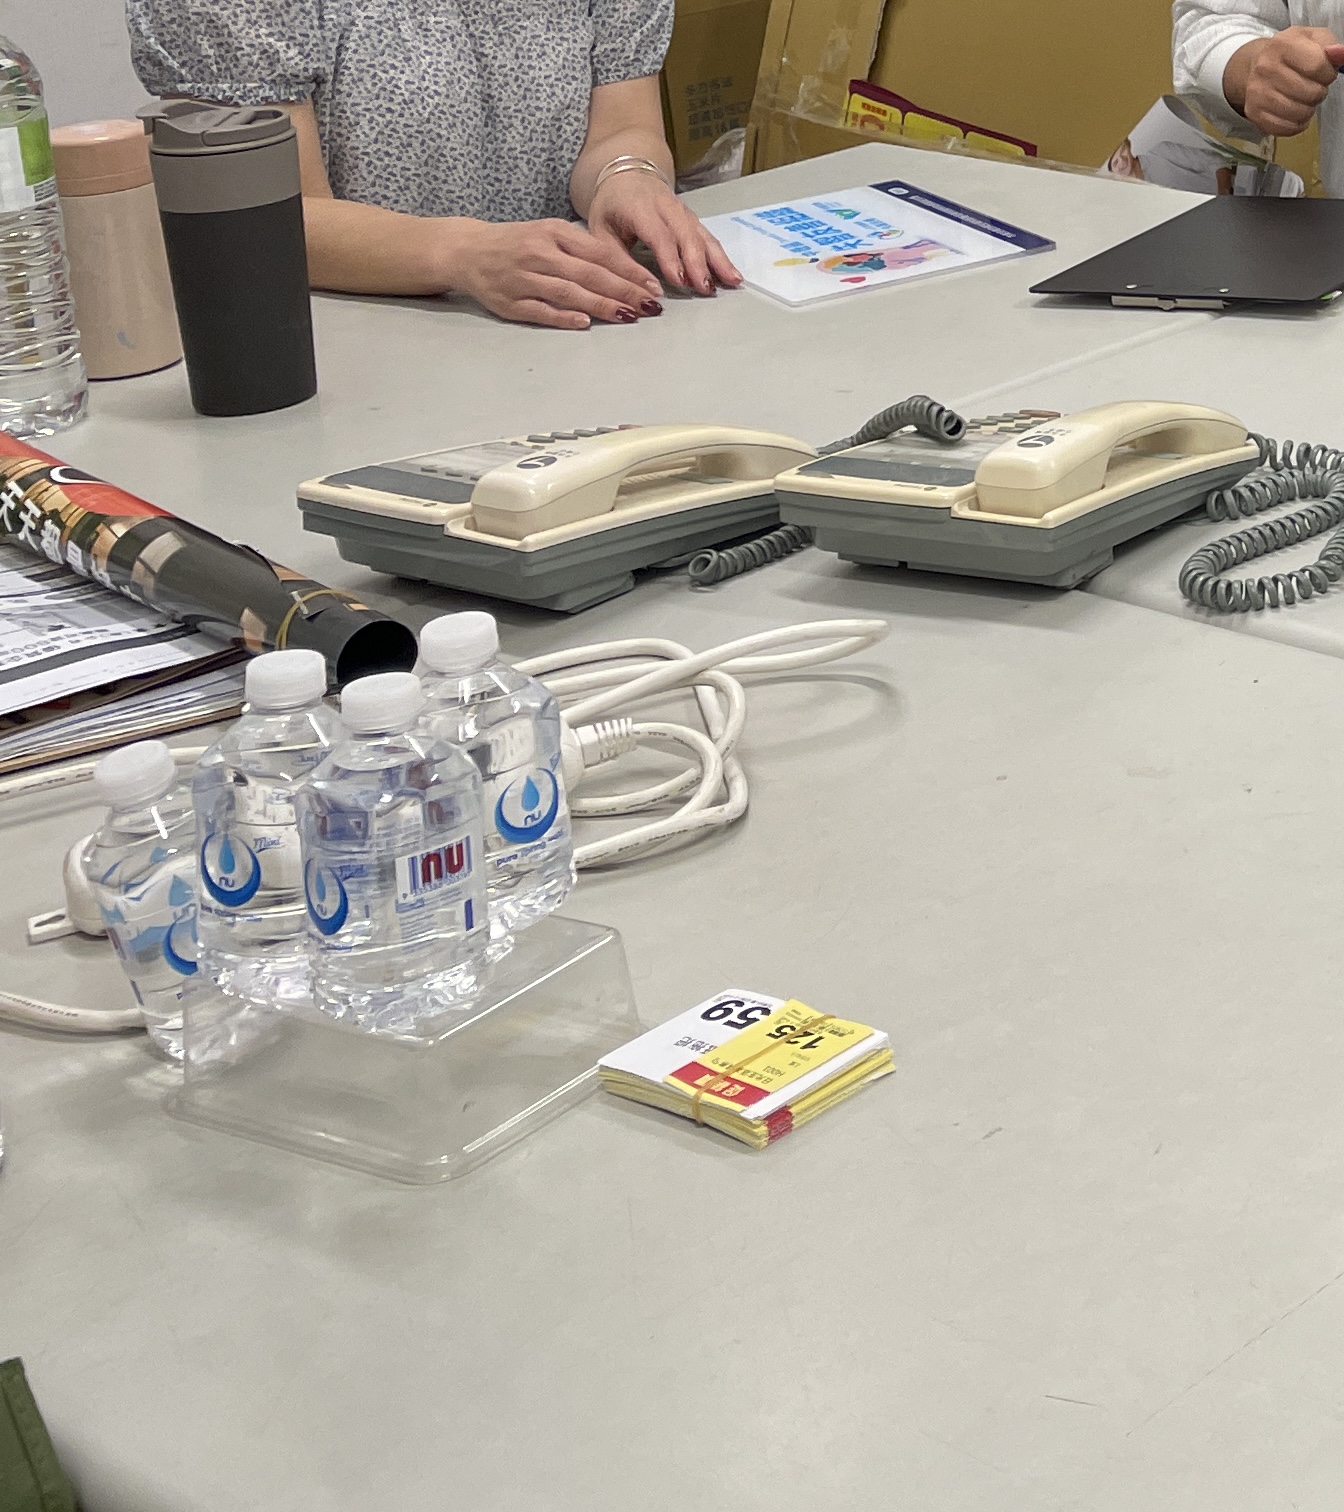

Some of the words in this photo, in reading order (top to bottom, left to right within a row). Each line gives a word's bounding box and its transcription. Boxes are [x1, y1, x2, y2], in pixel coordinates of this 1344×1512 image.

[422, 842, 464, 884] nu
[218, 876, 235, 887] nu
[700, 999, 772, 1030] 59
[765, 1024, 826, 1050] 125
